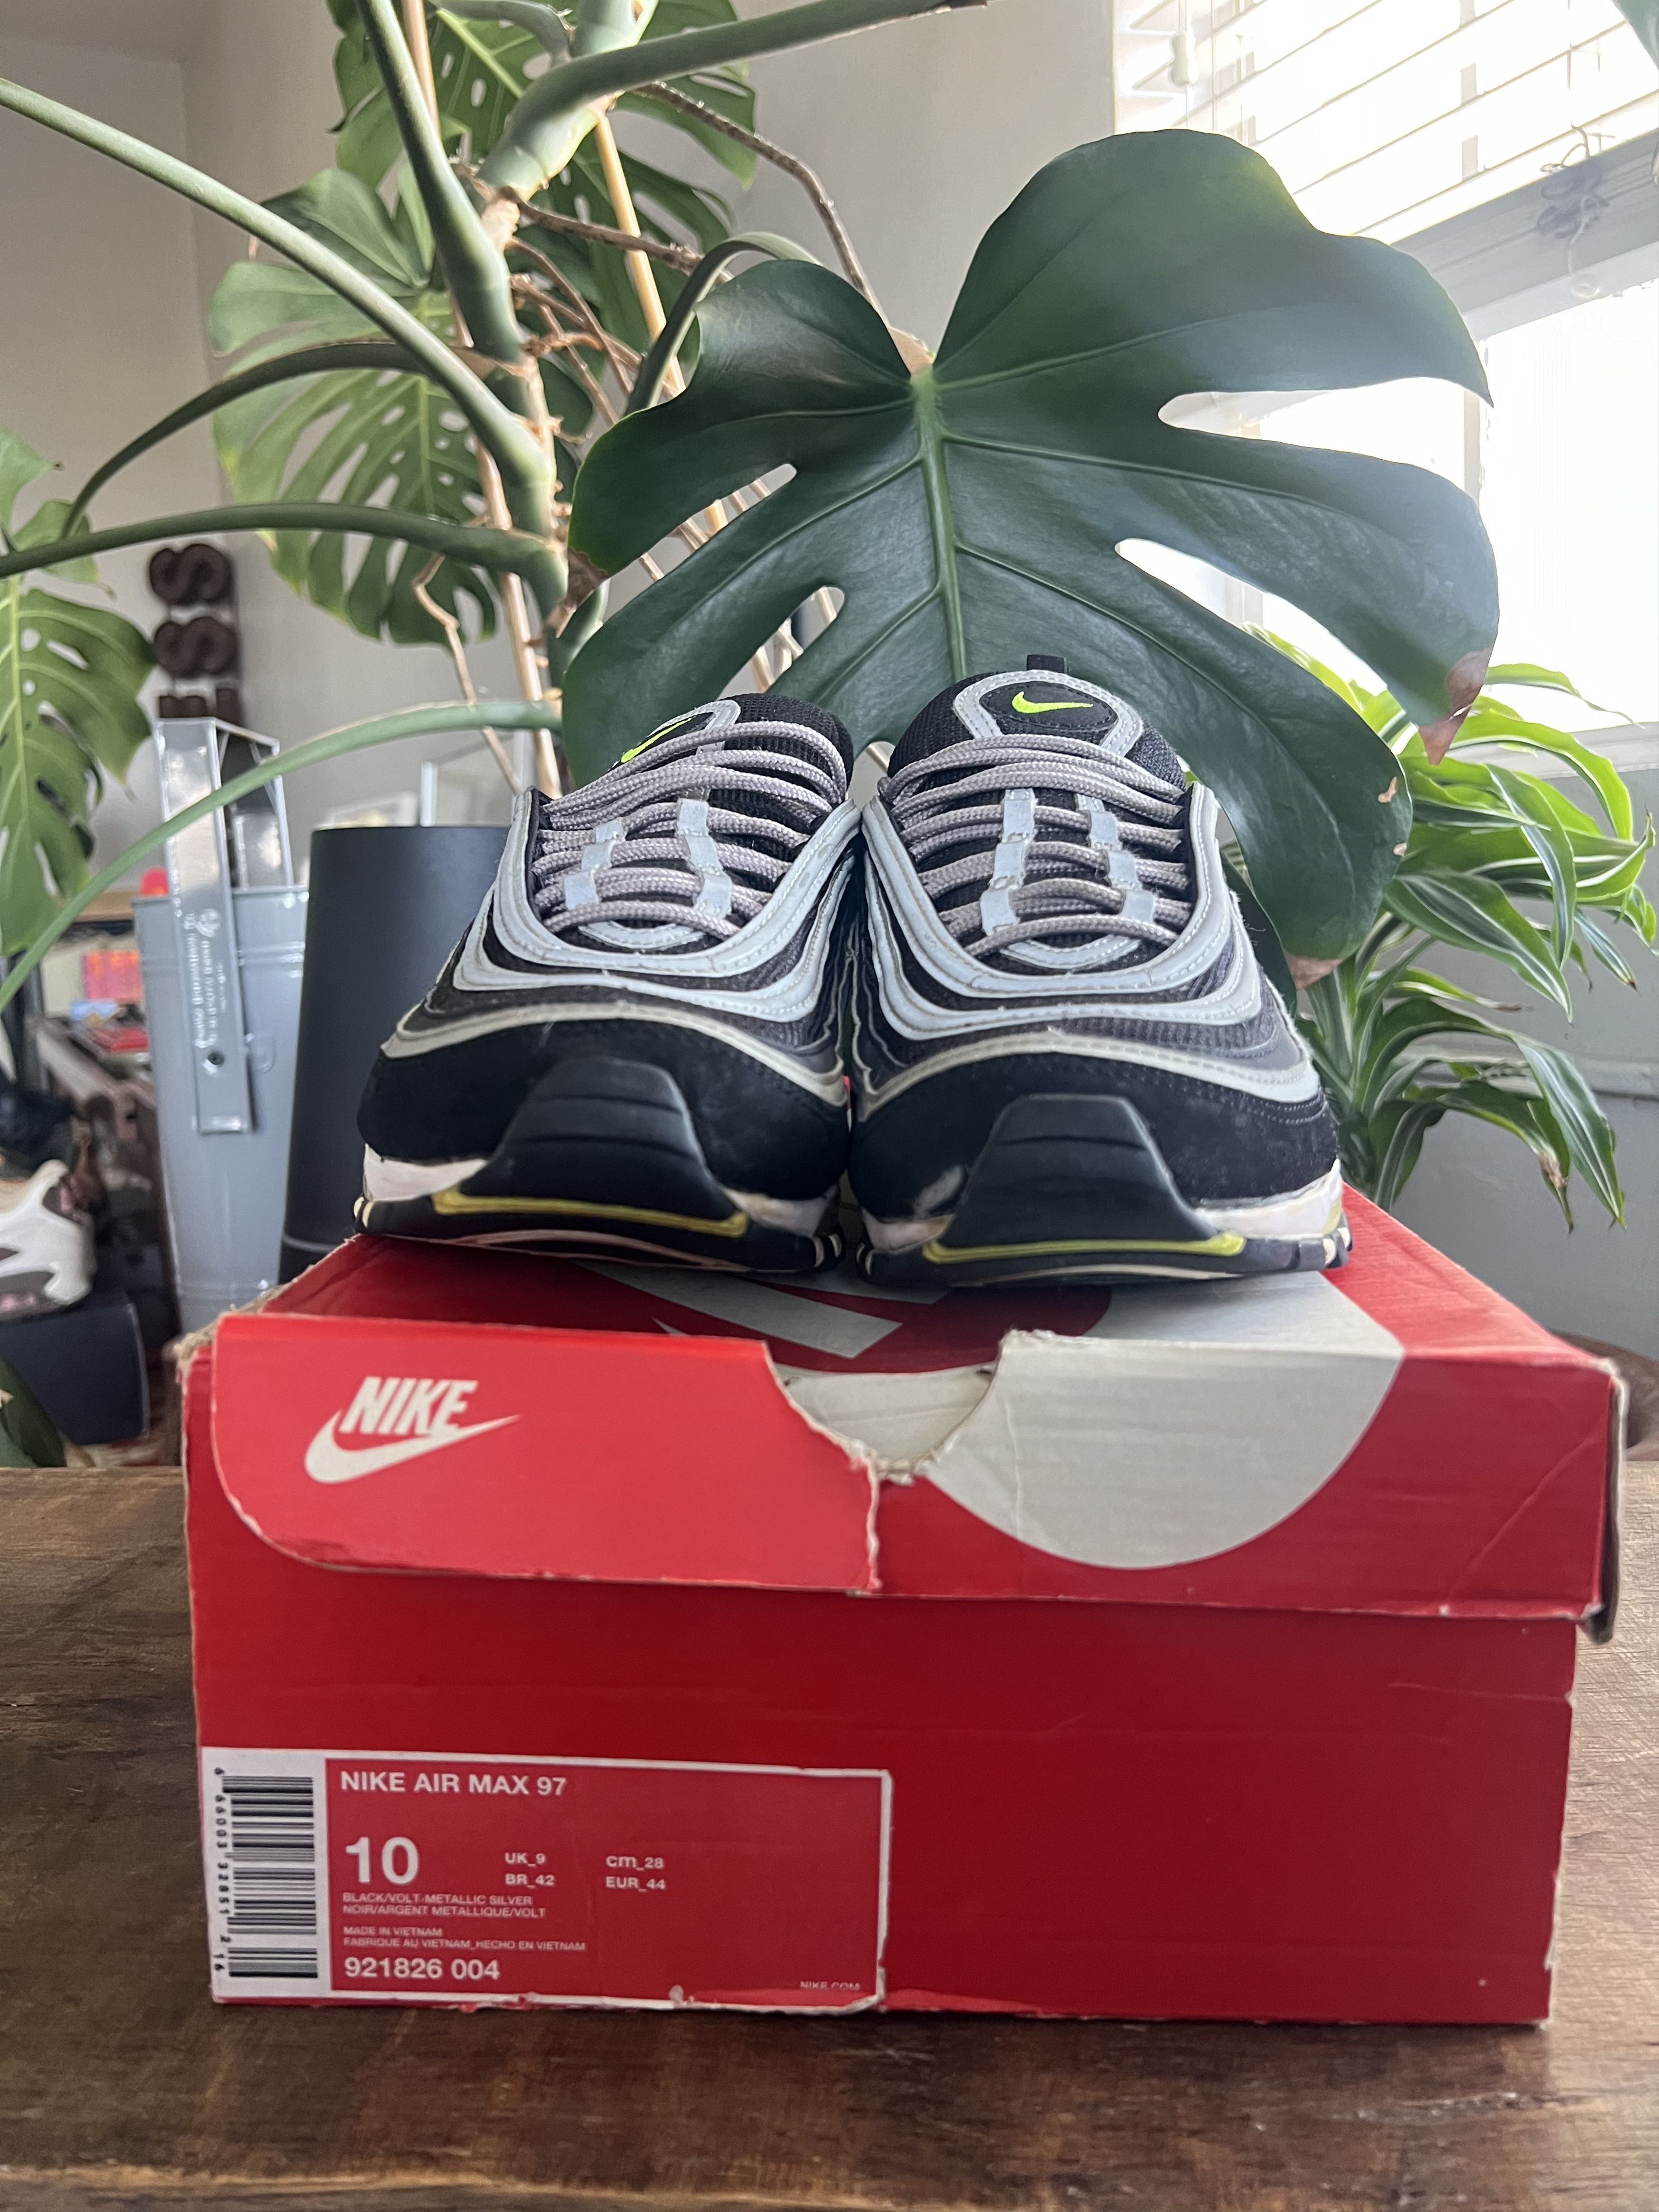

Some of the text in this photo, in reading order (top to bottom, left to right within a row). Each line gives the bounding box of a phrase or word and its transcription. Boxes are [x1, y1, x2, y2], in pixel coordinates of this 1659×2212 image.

[339, 1376, 478, 1436] NIKE
[214, 1767, 225, 1776] 6
[341, 1771, 566, 1795] NIKE AIR MAX 97
[215, 1794, 228, 1849] 66003
[346, 1836, 419, 1884] 10
[504, 1853, 546, 1867] UK_9
[217, 1862, 230, 1915] 32851
[505, 1874, 555, 1889] BR_42
[606, 1876, 665, 1892] EUR_44
[489, 1895, 533, 1905] SILVER
[343, 1904, 545, 1918] NOIR/ARGENT METALLIQUE/VOLT
[219, 1934, 231, 1943] 2
[344, 1926, 443, 1937] MADE IN VIETNAM
[344, 1937, 401, 1947] FABRIQUE
[403, 1938, 419, 1948] AU
[519, 1940, 534, 1950] EN
[536, 1941, 586, 1951] VIETNAM
[344, 1957, 500, 1980] 921826 004
[800, 1981, 860, 1991] NIKE.COM
